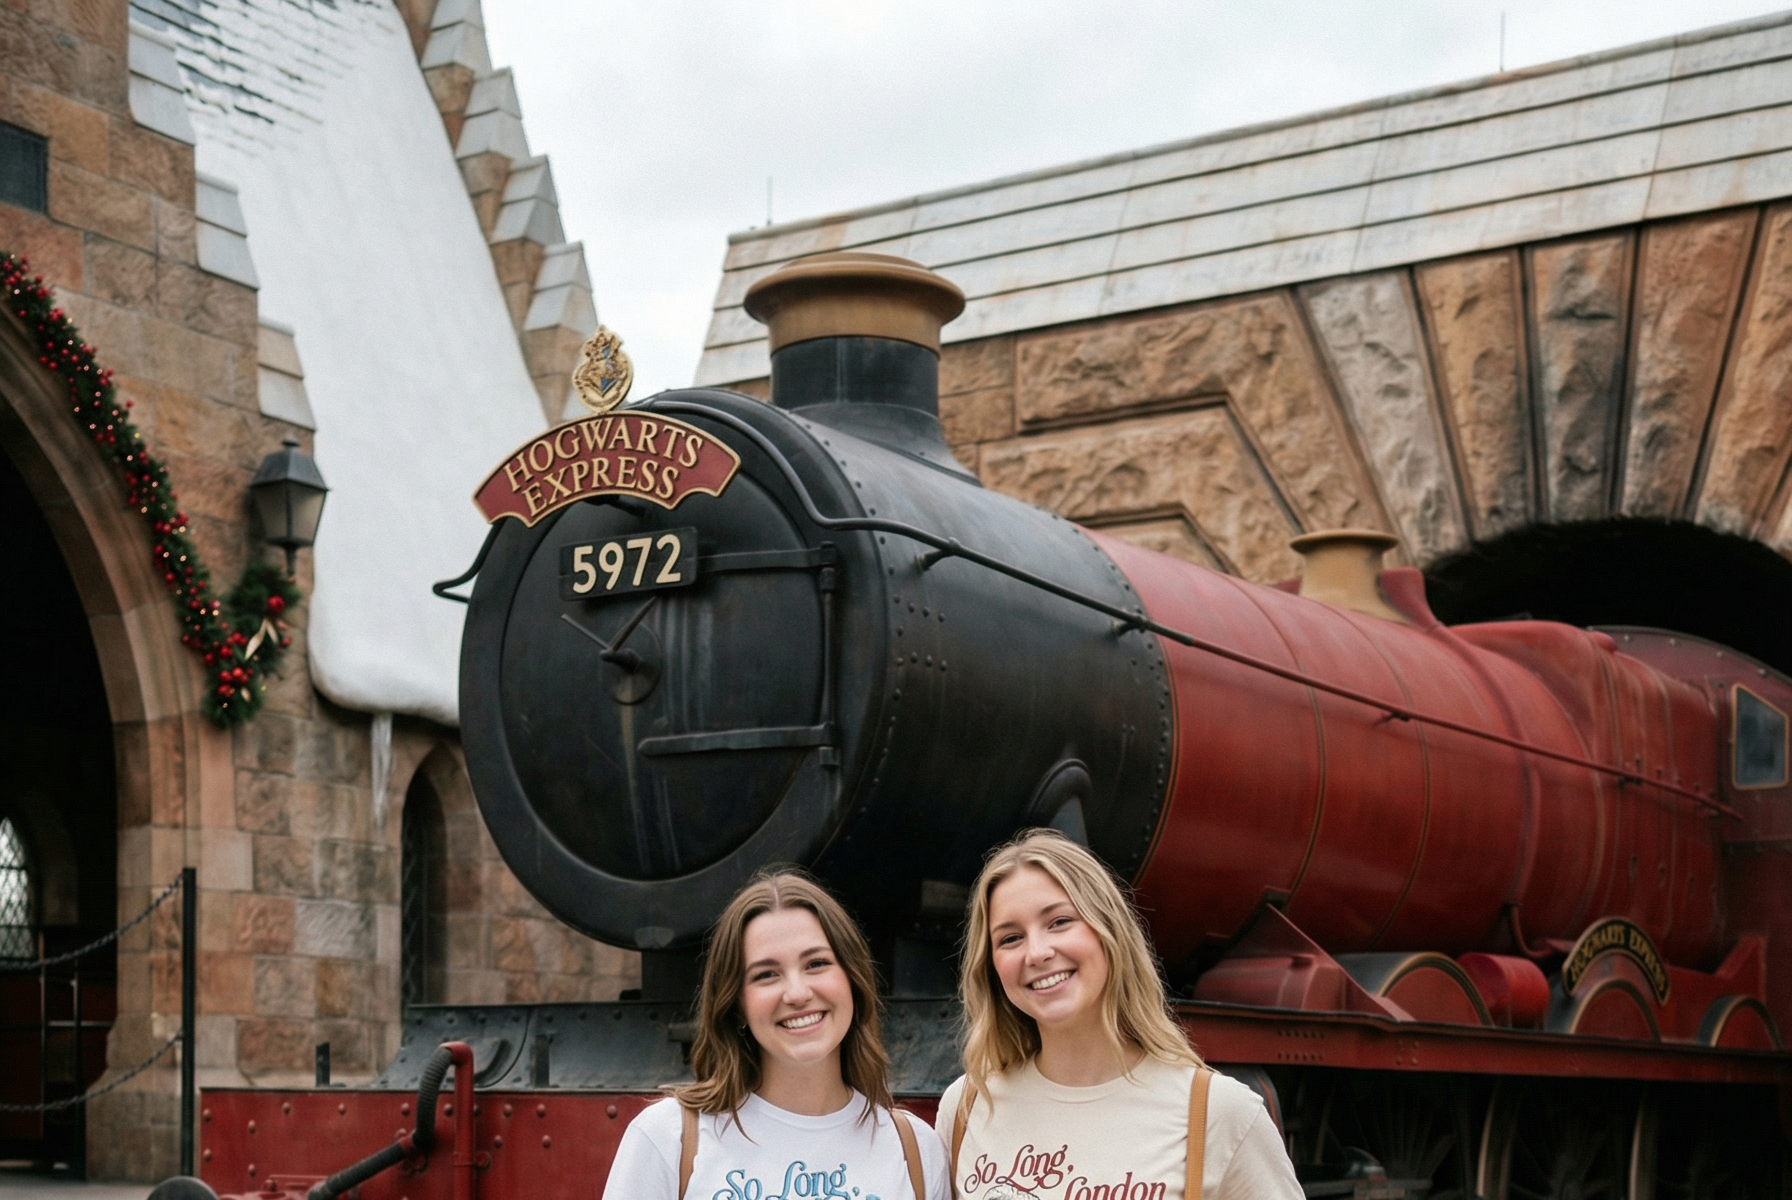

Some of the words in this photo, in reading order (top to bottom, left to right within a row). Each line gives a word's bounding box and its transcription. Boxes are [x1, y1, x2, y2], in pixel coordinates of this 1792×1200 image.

[503, 418, 703, 492] HOGWARTS
[522, 456, 679, 517] EXPRESS
[572, 533, 682, 594] 5972
[964, 1153, 997, 1194] So
[995, 1144, 1074, 1192] Long,
